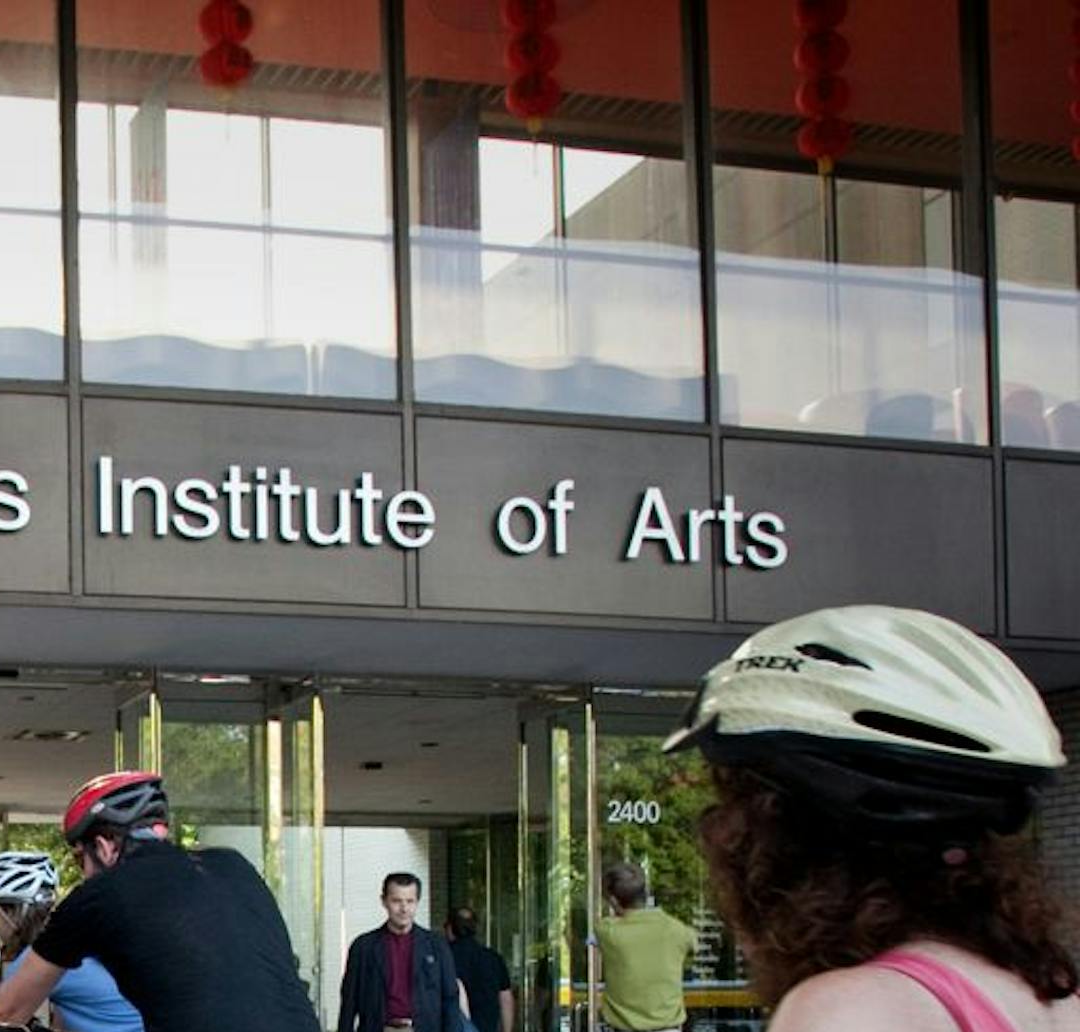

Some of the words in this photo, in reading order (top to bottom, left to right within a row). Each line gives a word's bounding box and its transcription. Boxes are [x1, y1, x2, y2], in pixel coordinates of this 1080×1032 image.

[98, 455, 437, 550] Institute
[497, 478, 576, 556] of
[626, 487, 789, 568] Arts
[734, 655, 805, 673] TREK
[607, 799, 662, 825] 2400
